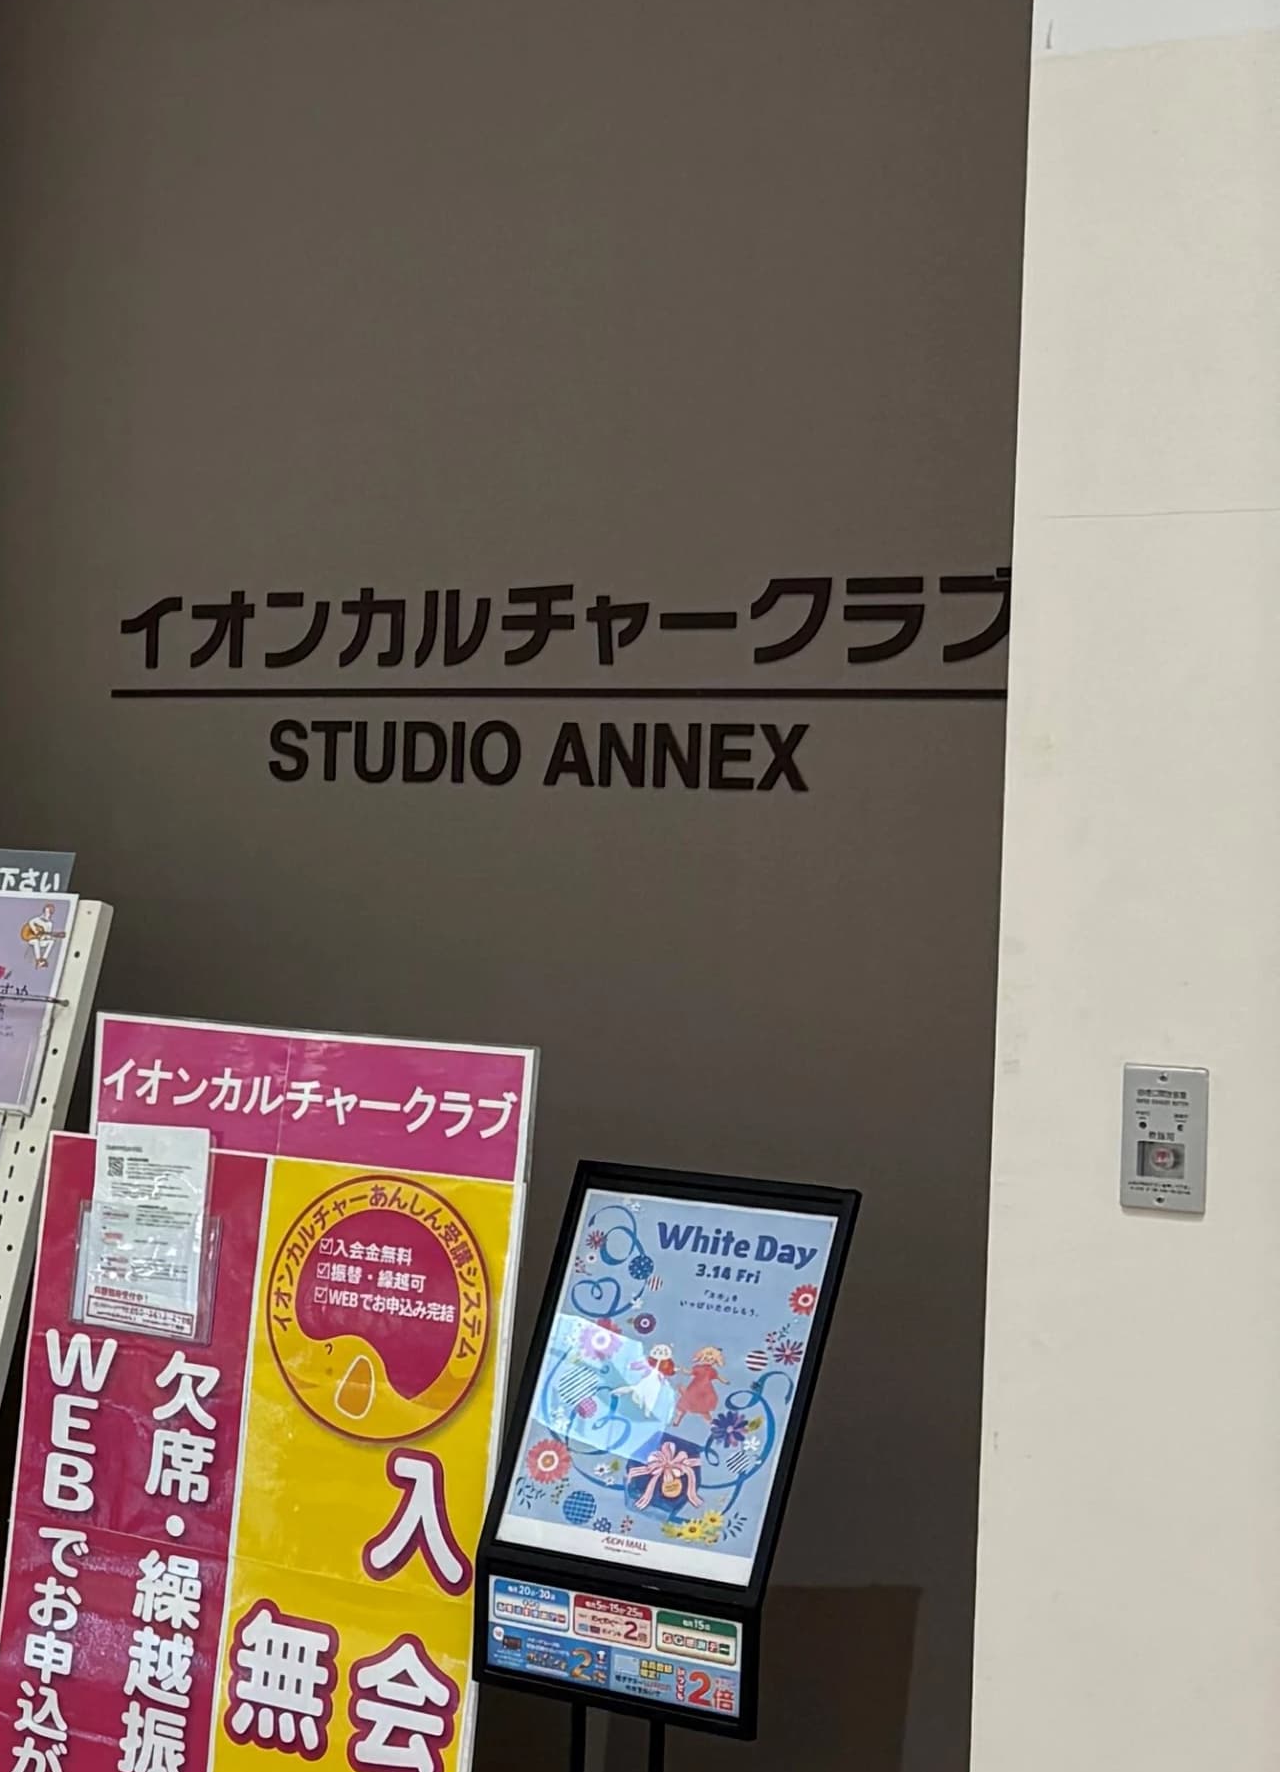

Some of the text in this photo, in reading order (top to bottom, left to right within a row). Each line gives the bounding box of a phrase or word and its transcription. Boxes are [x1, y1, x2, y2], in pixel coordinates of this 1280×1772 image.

[269, 720, 809, 793] STUDIO ANNEX
[102, 1058, 519, 1140] イオンカルチャークラブ
[332, 1239, 412, 1266] 入会金無料
[657, 1221, 818, 1270] White Day
[273, 1184, 482, 1359] イオンカルチャーあんしん受講システム
[331, 1263, 427, 1293] 振替・繰越可
[695, 1263, 762, 1284] 3.14 Fri
[329, 1290, 456, 1324] WEBでお申込み完結
[680, 1300, 760, 1317] いっぱいたのしもう。
